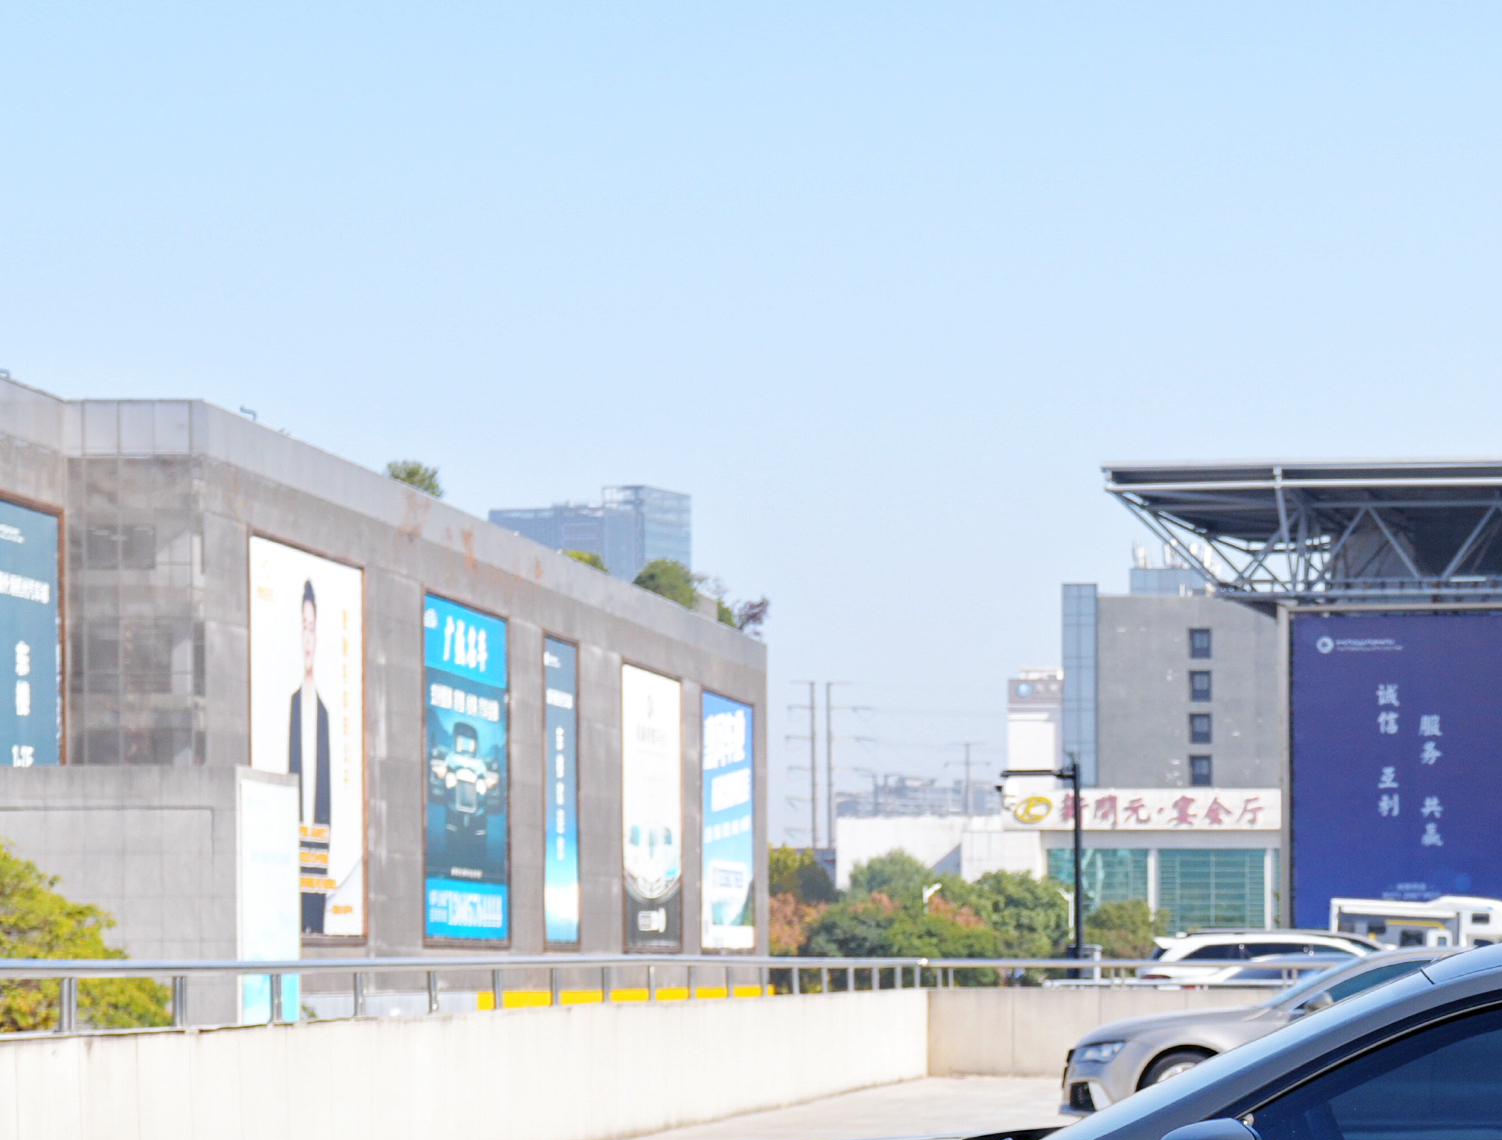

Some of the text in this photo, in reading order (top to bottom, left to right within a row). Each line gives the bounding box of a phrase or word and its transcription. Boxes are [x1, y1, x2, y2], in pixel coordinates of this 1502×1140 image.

[1376, 683, 1400, 817] 诚信 互利
[1418, 714, 1444, 847] 服务 共赢
